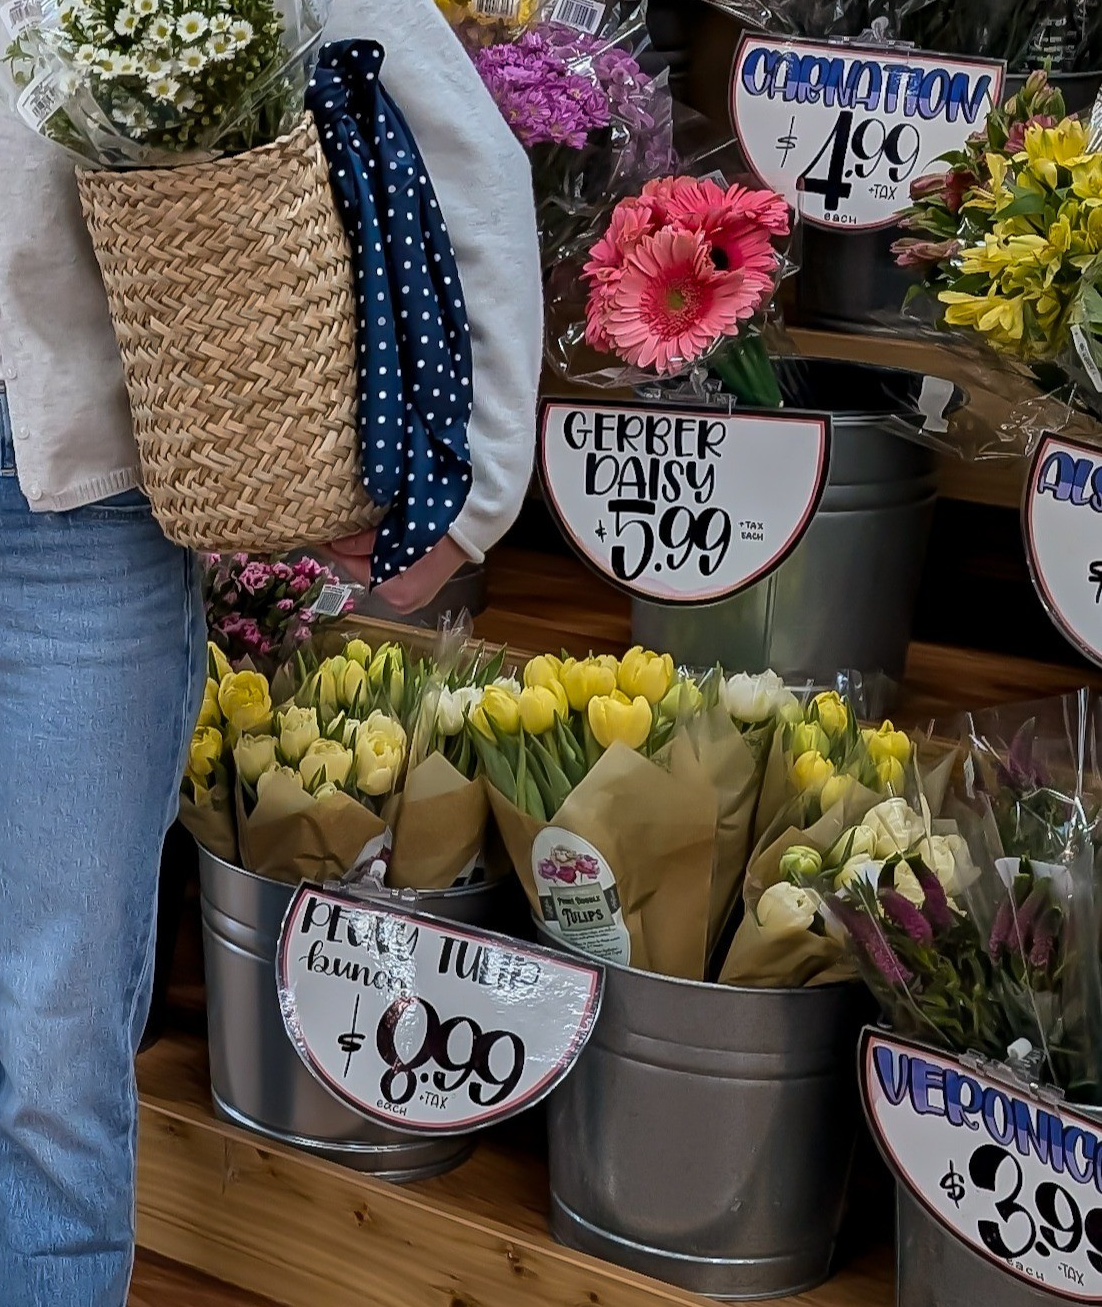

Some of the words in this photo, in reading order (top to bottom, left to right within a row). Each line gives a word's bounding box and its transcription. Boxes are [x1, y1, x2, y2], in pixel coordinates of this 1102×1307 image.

[741, 47, 993, 124] CARNATION
[563, 411, 726, 459] GERBER
[585, 452, 716, 504] DAISY
[741, 531, 765, 542] EACH
[561, 907, 604, 927] TULIPS
